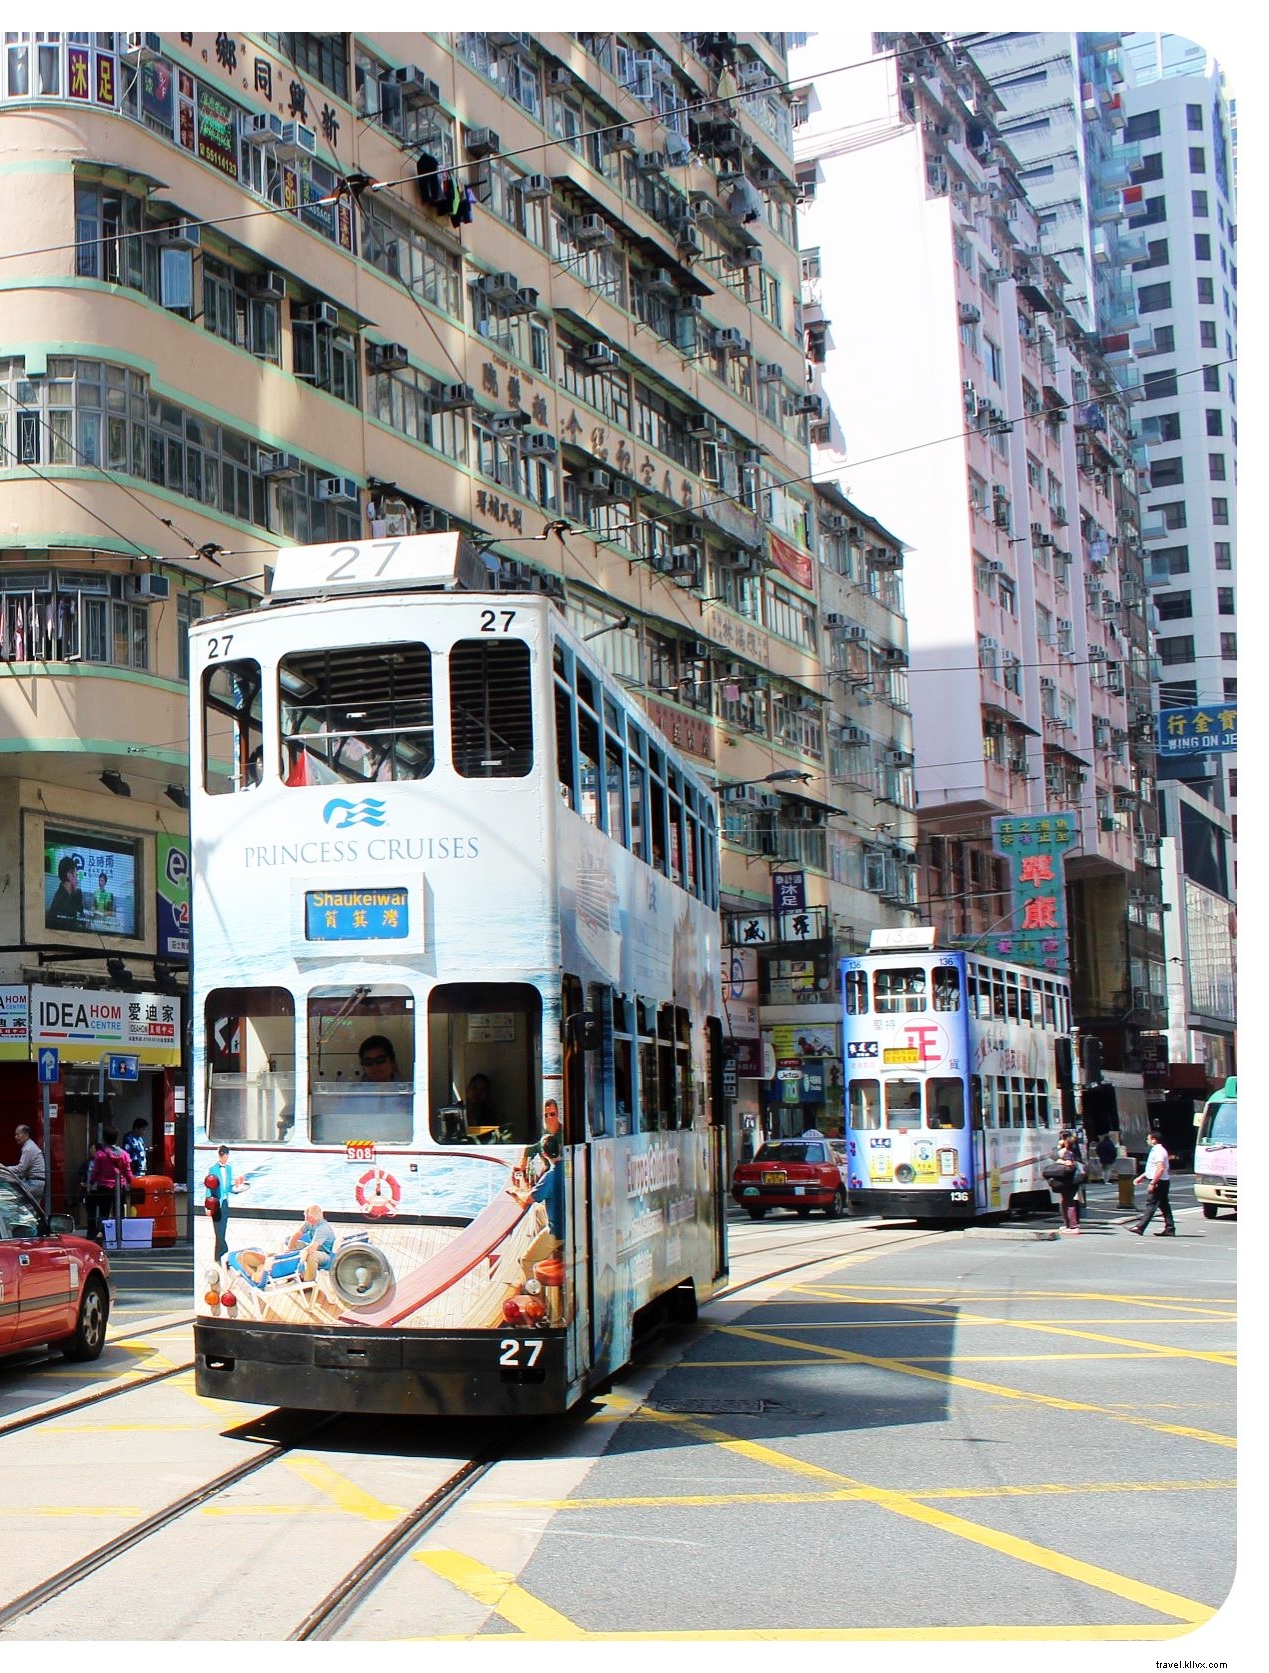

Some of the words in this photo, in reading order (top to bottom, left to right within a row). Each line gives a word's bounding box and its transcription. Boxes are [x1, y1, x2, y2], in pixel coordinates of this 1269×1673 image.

[326, 541, 401, 581] 27
[480, 610, 517, 633] 27
[208, 635, 234, 659] 27
[1202, 735, 1219, 747] ON
[244, 840, 358, 868] PRINCESS
[367, 836, 480, 861] CRUISES
[325, 909, 399, 929] 筲箕灣
[5, 995, 27, 1003] HOM
[40, 1001, 89, 1029] IDEA
[90, 1004, 121, 1019] HOM
[91, 1020, 121, 1031] CENTRE
[347, 1147, 372, 1160] S08
[950, 1191, 969, 1202] 136
[499, 1339, 543, 1367] 27
